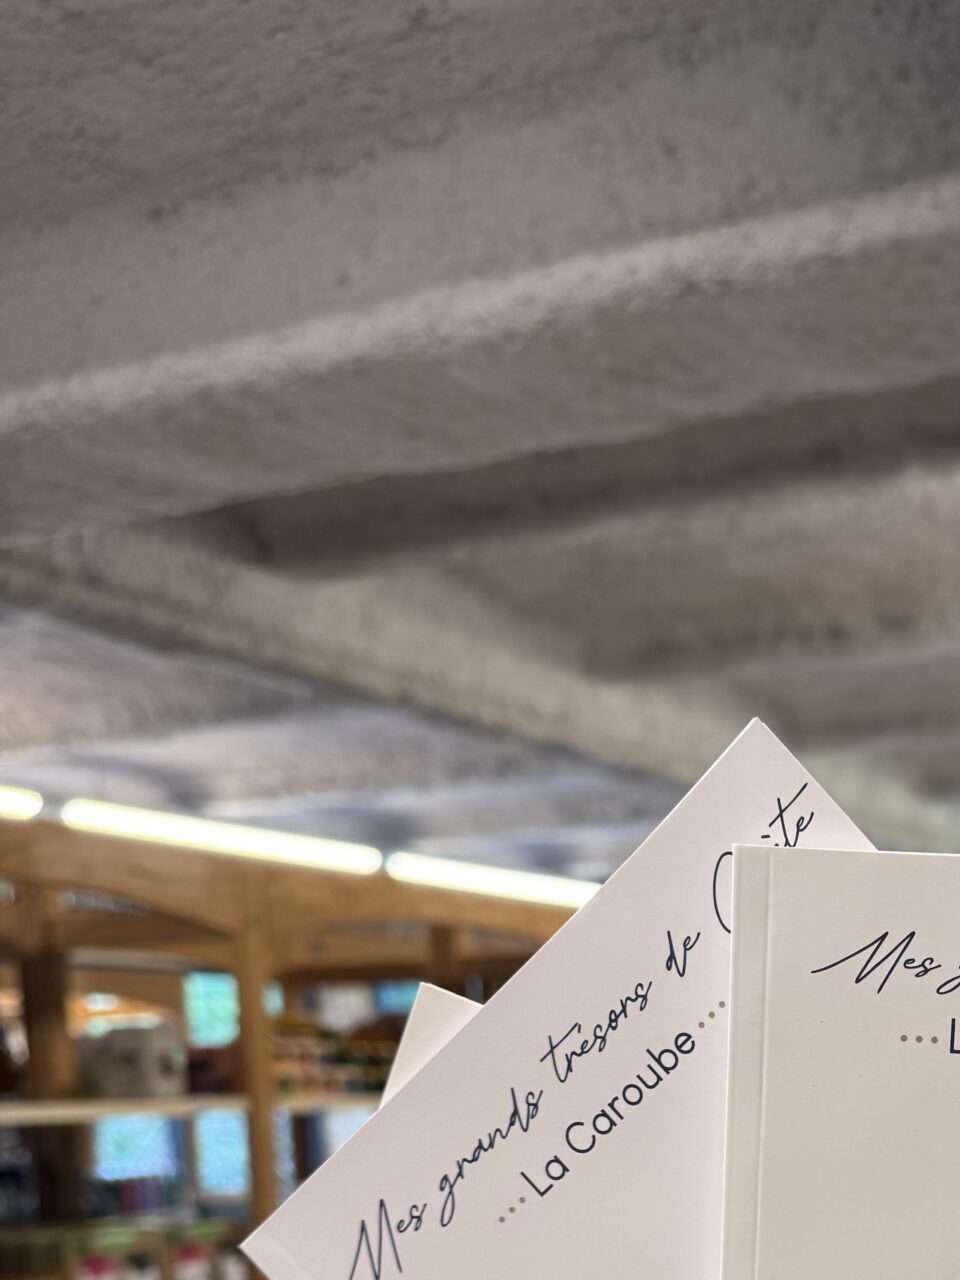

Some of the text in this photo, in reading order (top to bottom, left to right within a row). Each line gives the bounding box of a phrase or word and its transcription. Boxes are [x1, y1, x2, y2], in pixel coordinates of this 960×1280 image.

[810, 930, 942, 995] Mes
[439, 1087, 544, 1228] grands
[539, 981, 653, 1084] trésors
[665, 930, 701, 978] de
[519, 1031, 696, 1198] La Caroube
